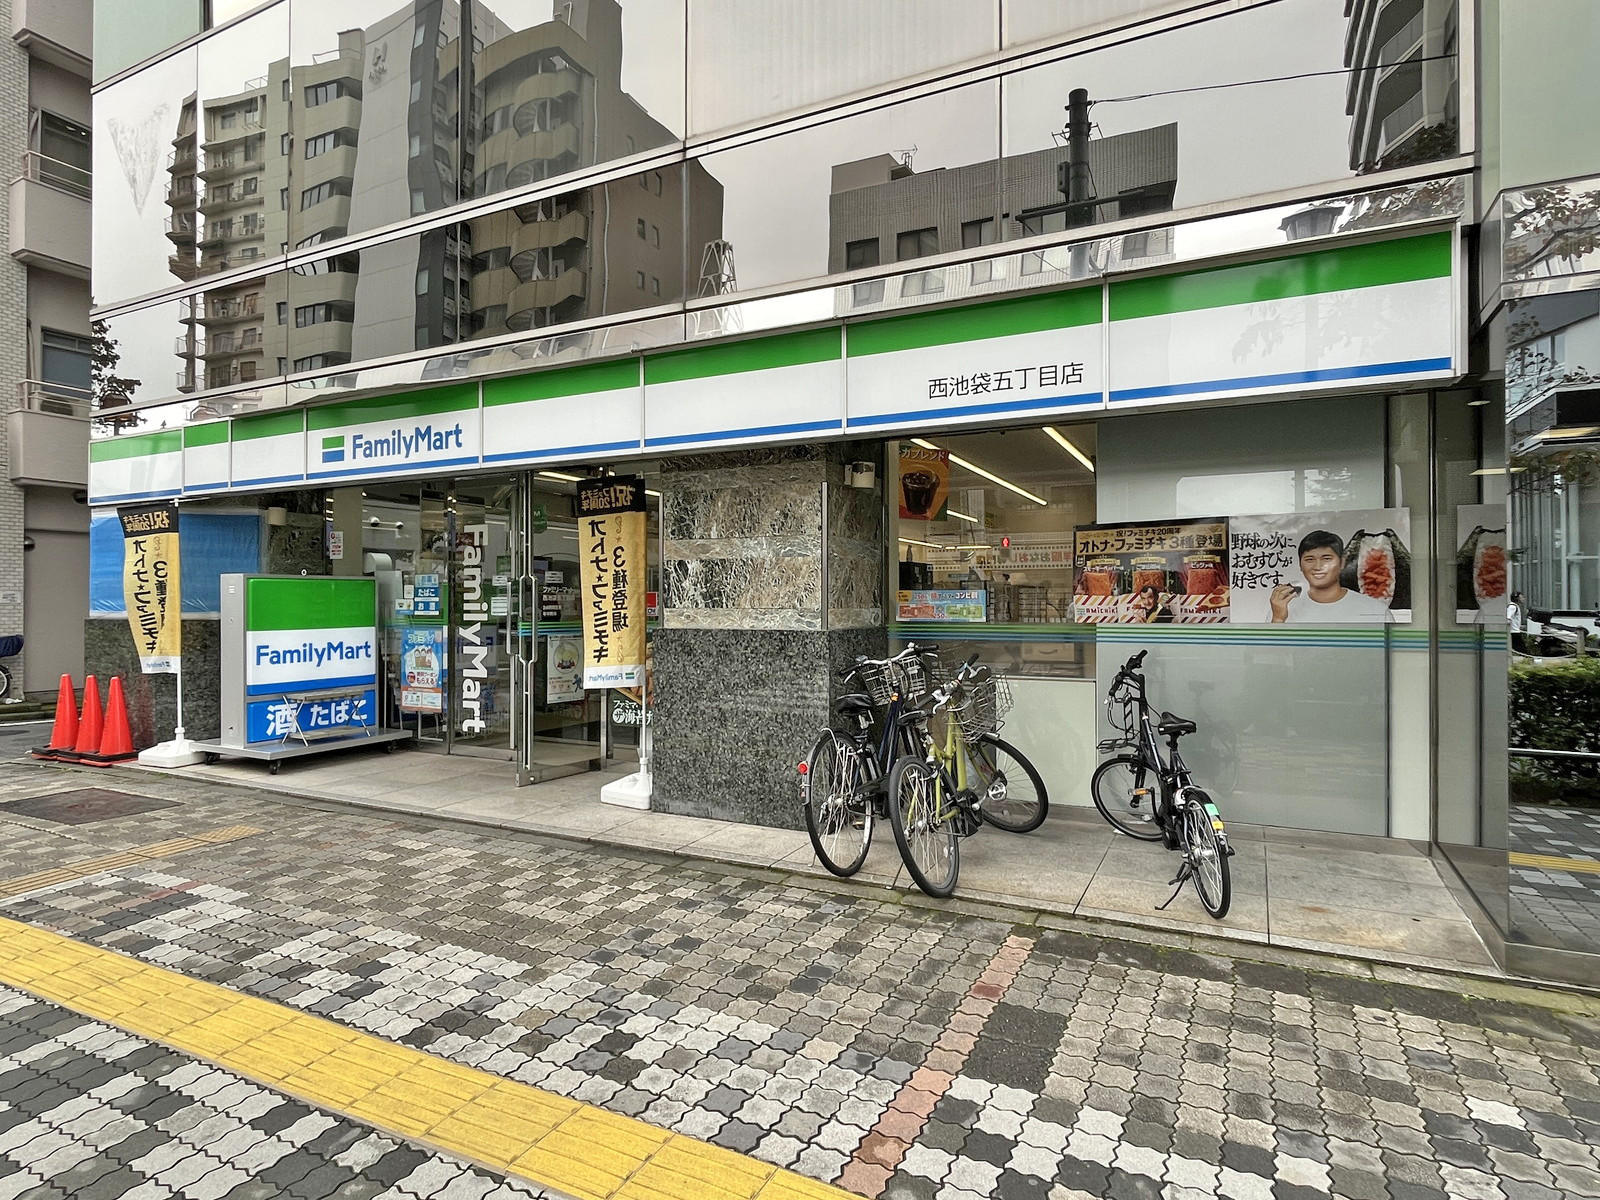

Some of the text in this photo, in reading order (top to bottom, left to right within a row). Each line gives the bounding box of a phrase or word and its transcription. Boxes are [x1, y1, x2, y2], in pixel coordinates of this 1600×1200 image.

[928, 362, 1084, 399] 西池袋五丁目店
[352, 423, 463, 459] FamilyMart
[899, 447, 946, 461] カブレンド
[1169, 534, 1223, 549] 3種登場
[1232, 551, 1293, 569] おむすびが
[418, 588, 435, 596] たばこ
[459, 524, 489, 733] FamilyMart
[256, 641, 371, 667] FamilyMart
[266, 700, 368, 736] 酒 たばこ
